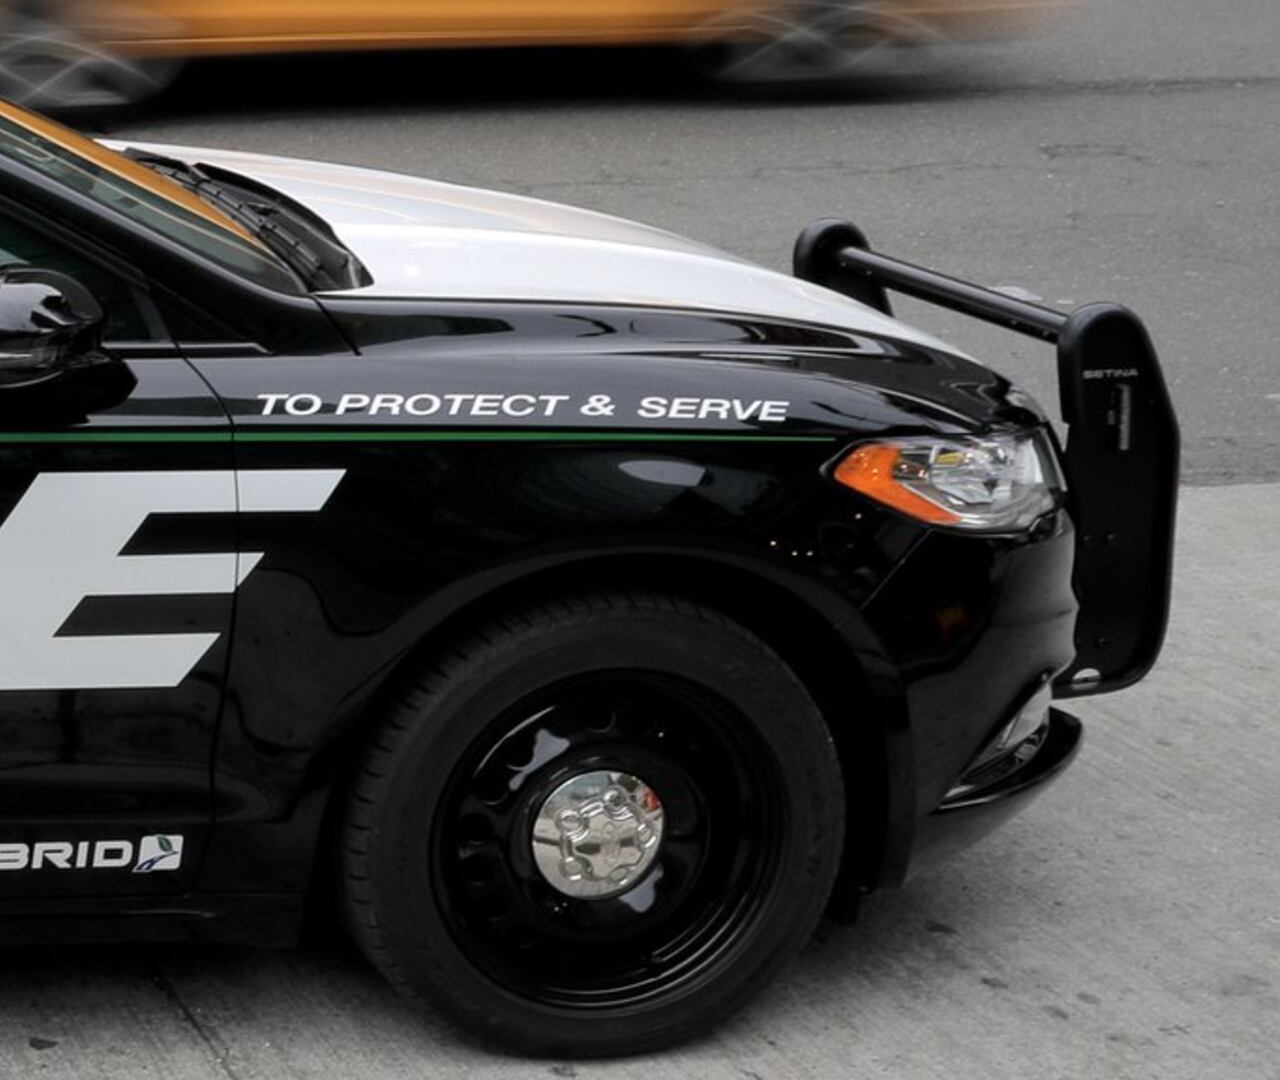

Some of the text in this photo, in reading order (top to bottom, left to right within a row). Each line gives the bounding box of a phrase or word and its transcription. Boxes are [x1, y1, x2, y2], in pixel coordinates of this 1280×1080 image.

[257, 394, 790, 422] TO PROTECT & SERVE
